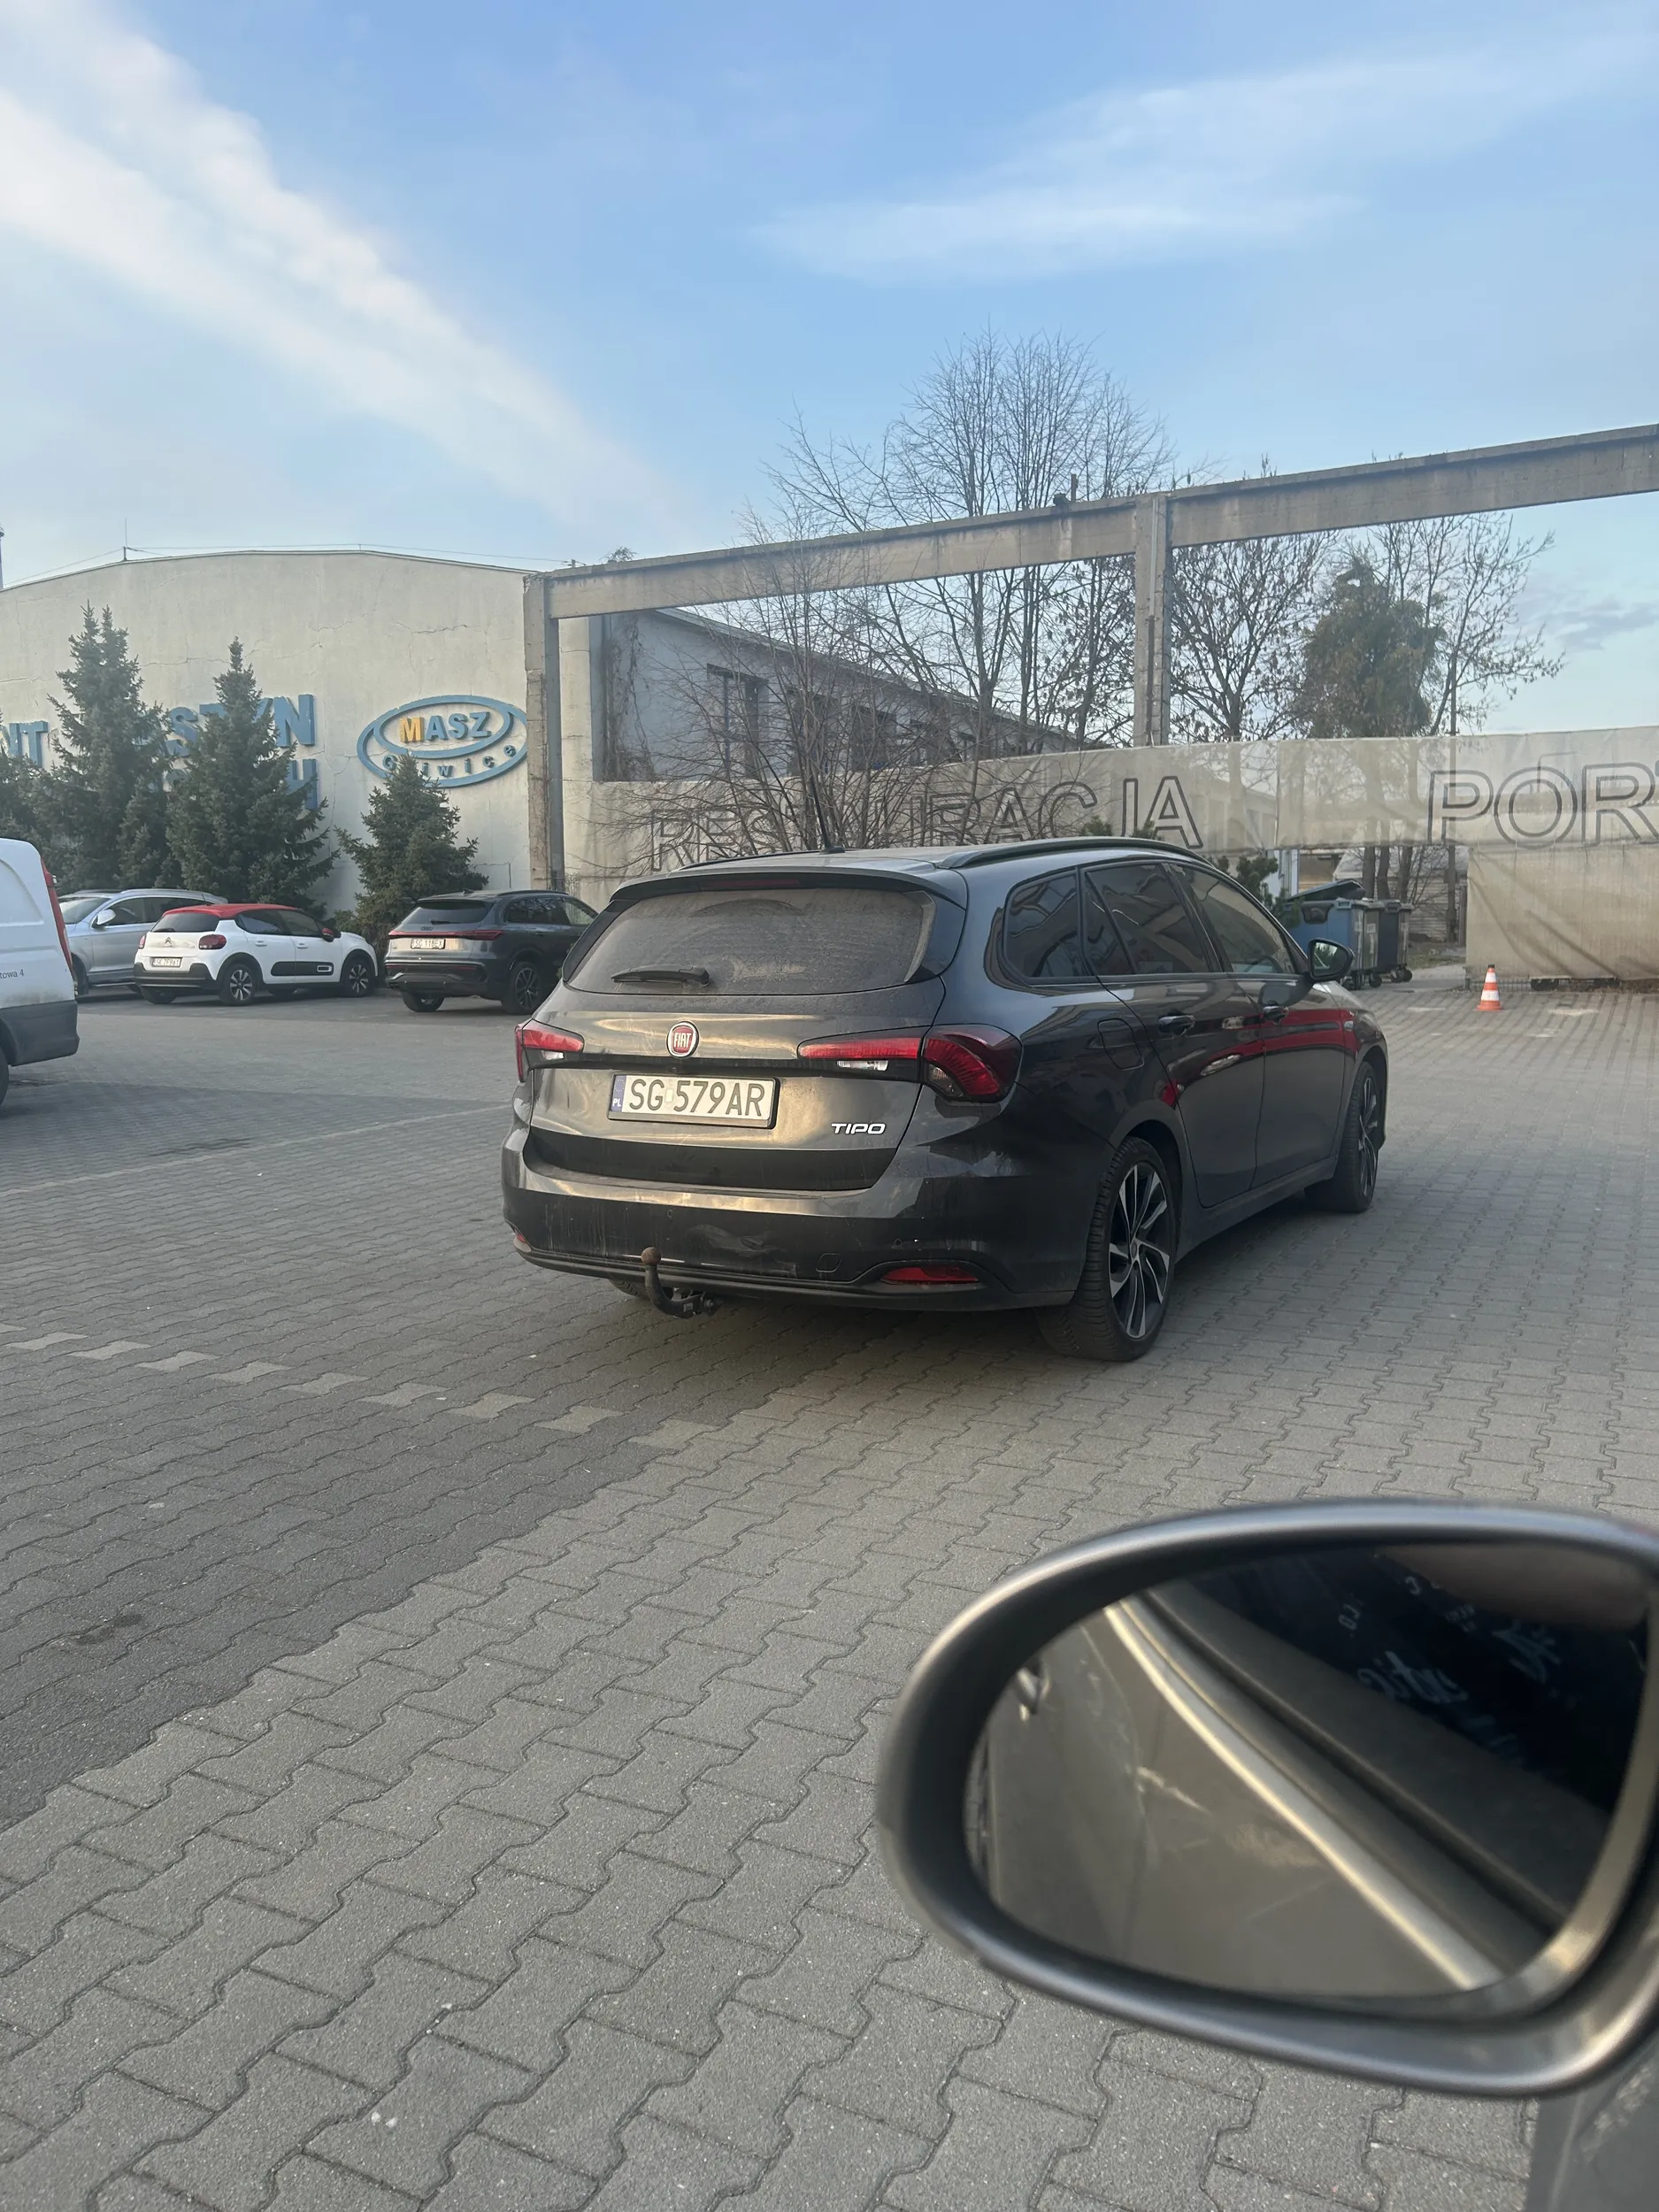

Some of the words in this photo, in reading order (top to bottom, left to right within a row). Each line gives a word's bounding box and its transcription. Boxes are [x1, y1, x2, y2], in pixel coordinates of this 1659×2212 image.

[400, 711, 491, 743] MASZ
[382, 744, 517, 778] Giwice
[651, 776, 1203, 872] RESURACJA
[1427, 761, 1659, 849] POR
[673, 1032, 692, 1048] FIAT
[611, 1098, 622, 1108] PL
[629, 1079, 664, 1111] SG
[673, 1079, 765, 1117] 579AR
[831, 1123, 886, 1134] TIPO
